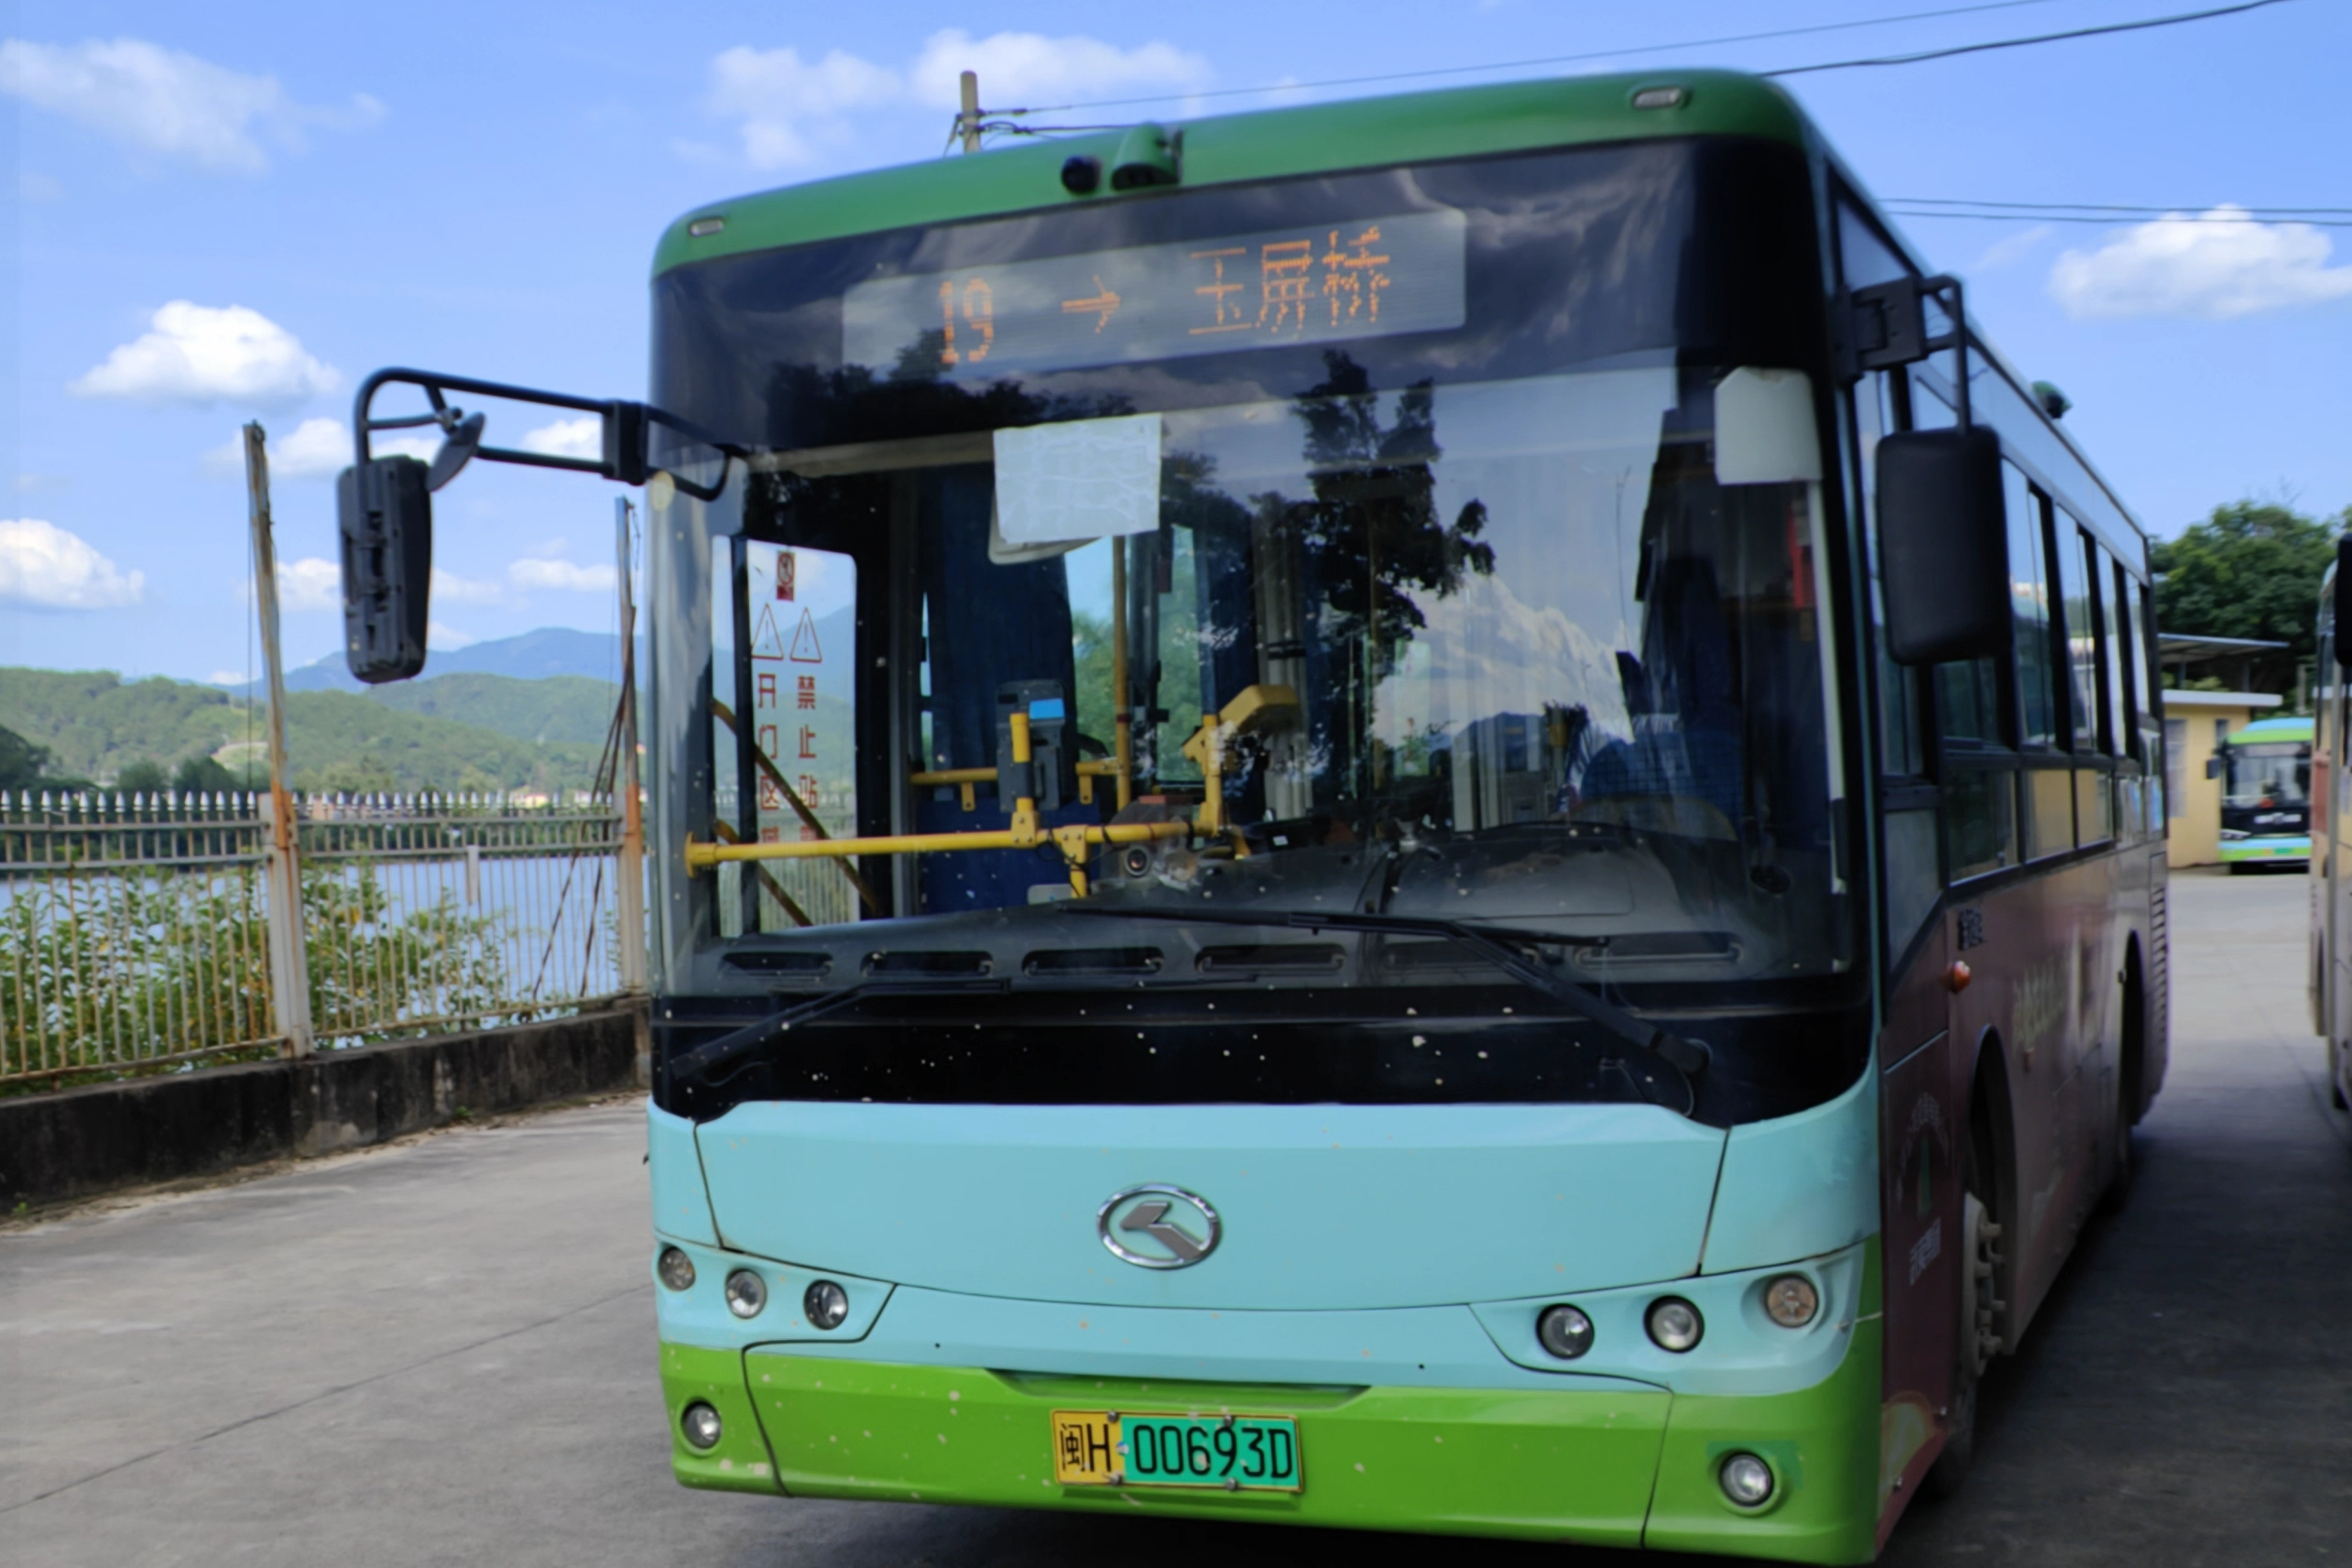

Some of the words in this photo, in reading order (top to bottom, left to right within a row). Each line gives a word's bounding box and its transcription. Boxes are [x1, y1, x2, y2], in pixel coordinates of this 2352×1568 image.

[940, 278, 995, 364] 19
[1189, 225, 1391, 340] 玉屏桥
[1060, 1422, 1111, 1473] 闽H
[1133, 1424, 1293, 1478] 00693D
